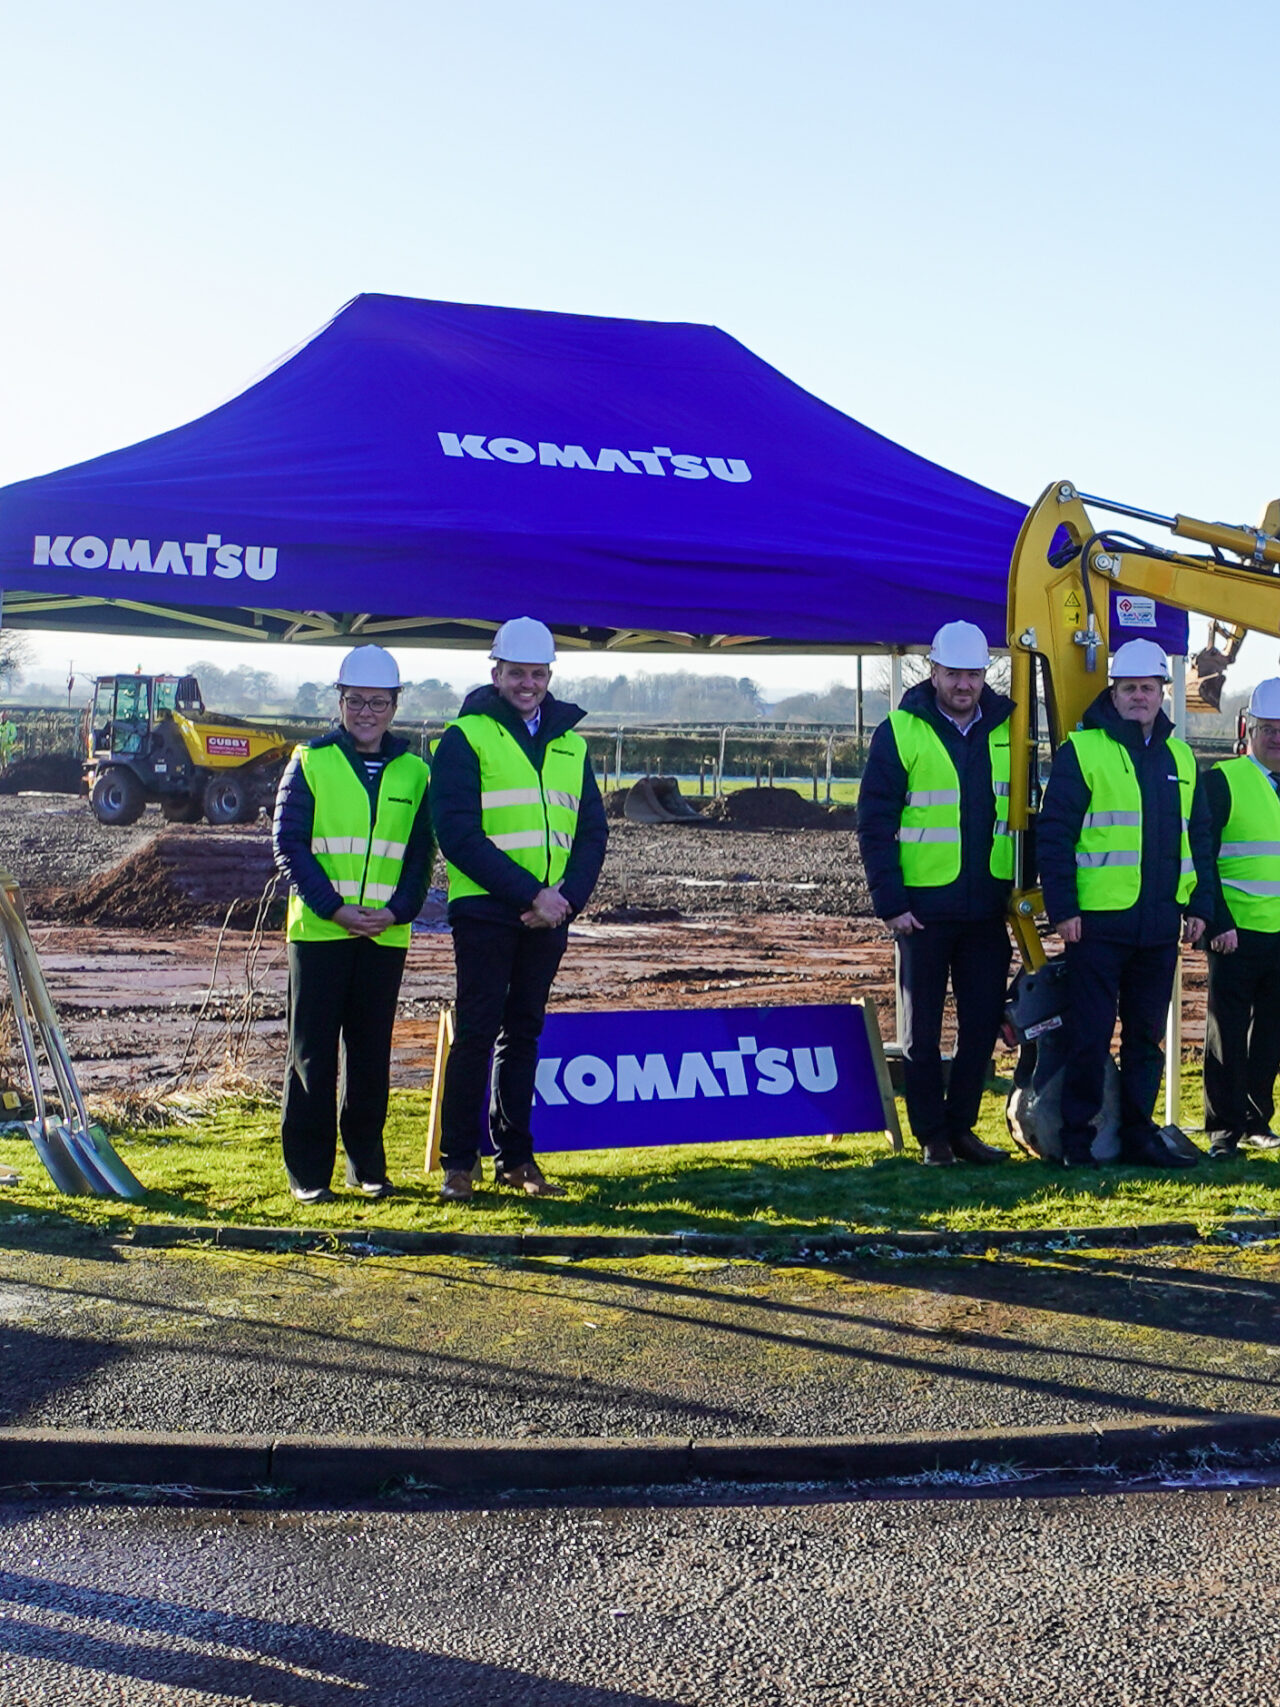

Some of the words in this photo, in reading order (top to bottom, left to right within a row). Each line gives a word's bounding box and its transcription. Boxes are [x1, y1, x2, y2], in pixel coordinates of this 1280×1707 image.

[437, 431, 752, 483] KOMATSU
[33, 533, 278, 581] KOMATSU
[208, 737, 248, 747] CUBBY
[532, 1035, 839, 1106] KOMATSU
